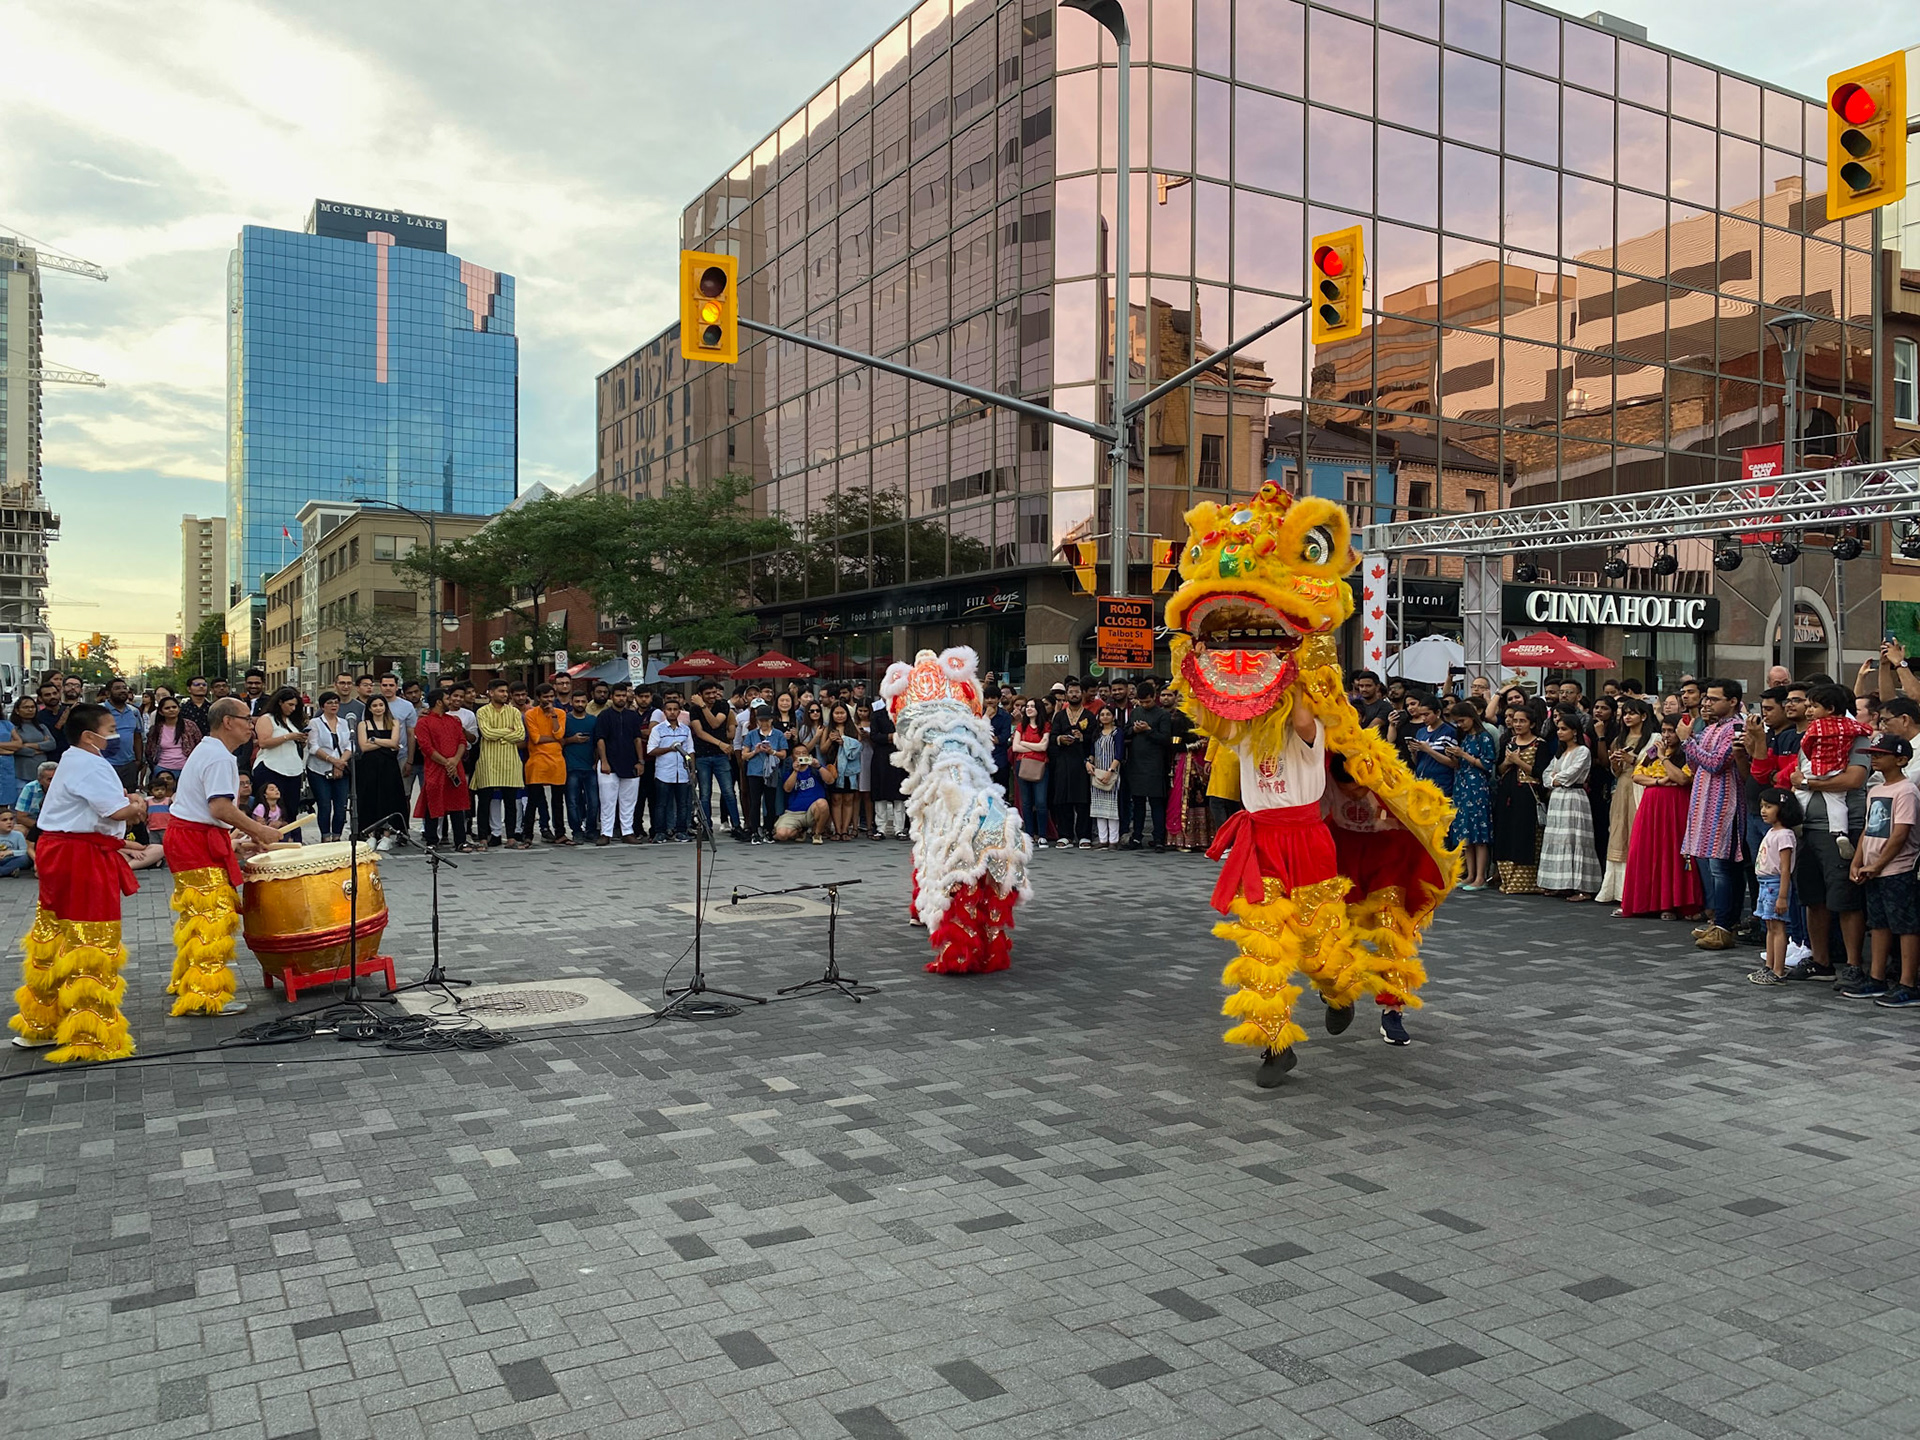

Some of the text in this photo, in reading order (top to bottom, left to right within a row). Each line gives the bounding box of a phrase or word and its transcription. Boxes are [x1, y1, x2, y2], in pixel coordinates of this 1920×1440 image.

[407, 216, 443, 230] LAKE
[1748, 462, 1776, 471] CANADA
[1752, 468, 1773, 478] DAY
[966, 596, 985, 608] FITZ
[851, 602, 949, 622] Food Drinks Entertainment
[1110, 604, 1141, 615] ROAD
[1526, 590, 1707, 630] CINNAHOLIC
[1104, 616, 1147, 627] CLOSED
[1108, 629, 1133, 638] Talbot
